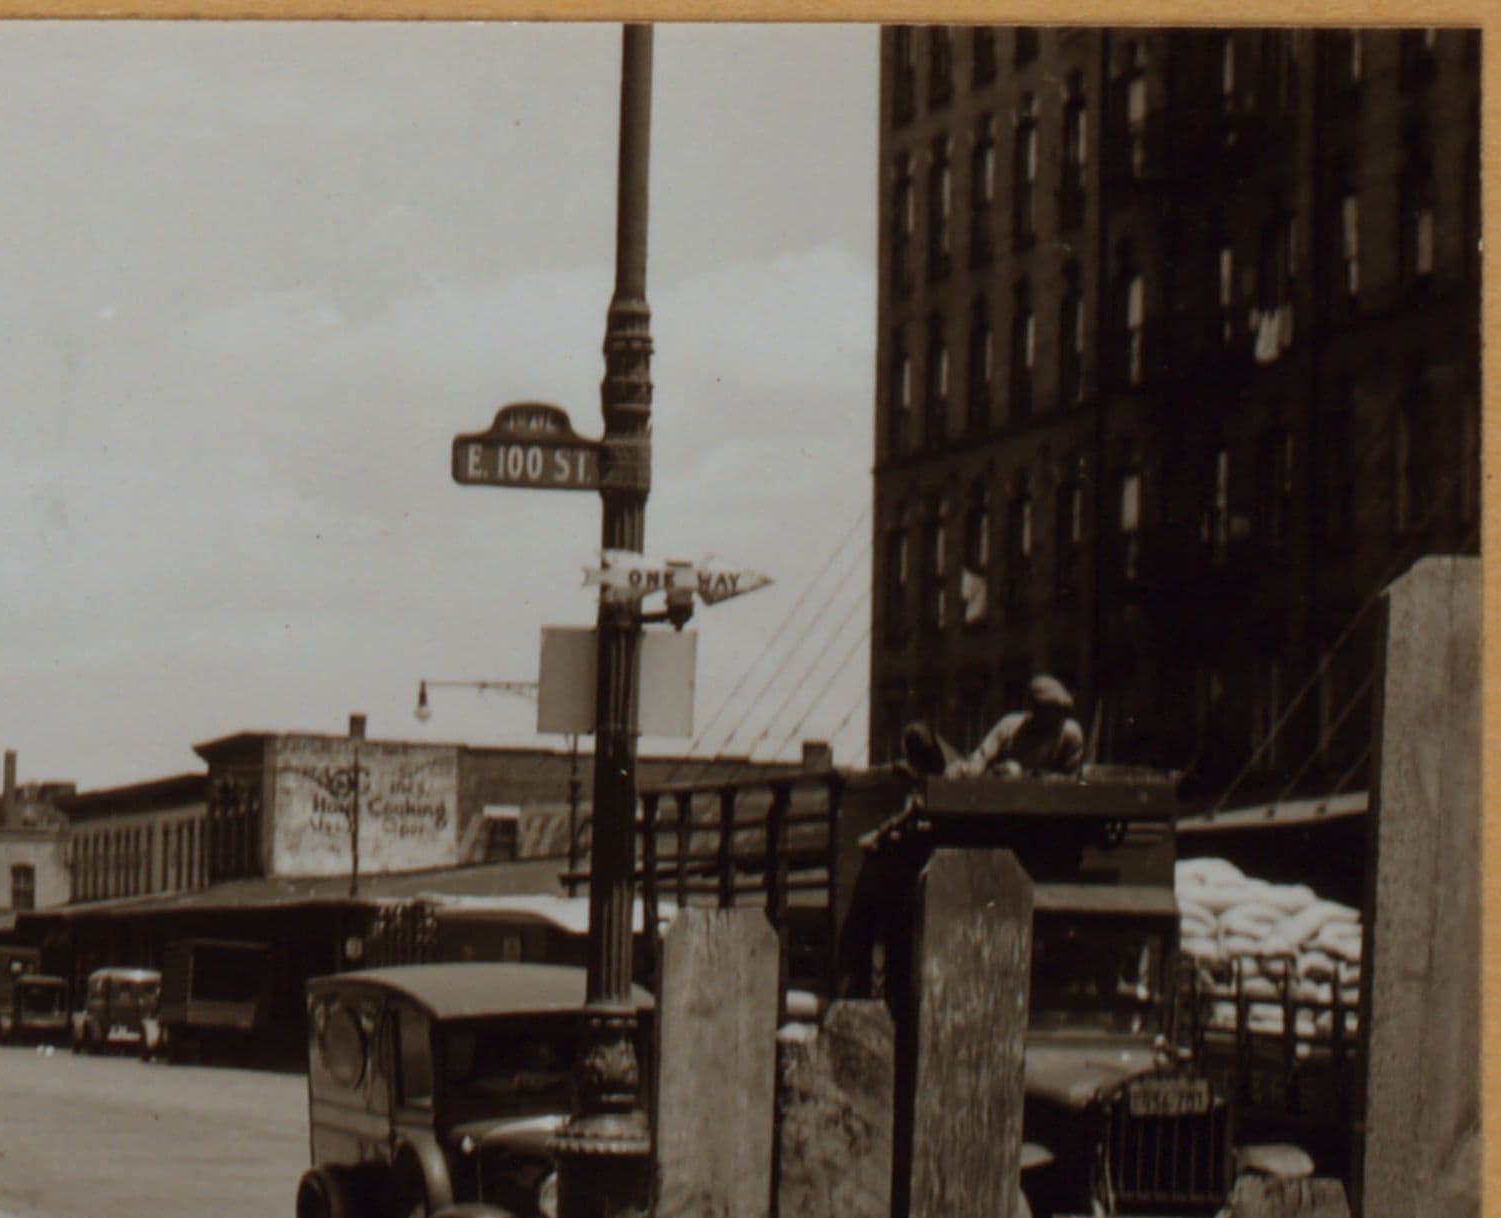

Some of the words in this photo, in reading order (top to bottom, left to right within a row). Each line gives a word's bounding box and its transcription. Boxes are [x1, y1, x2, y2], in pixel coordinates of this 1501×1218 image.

[498, 445, 543, 480] 100
[628, 570, 675, 588] ONE
[697, 572, 741, 591] WAY
